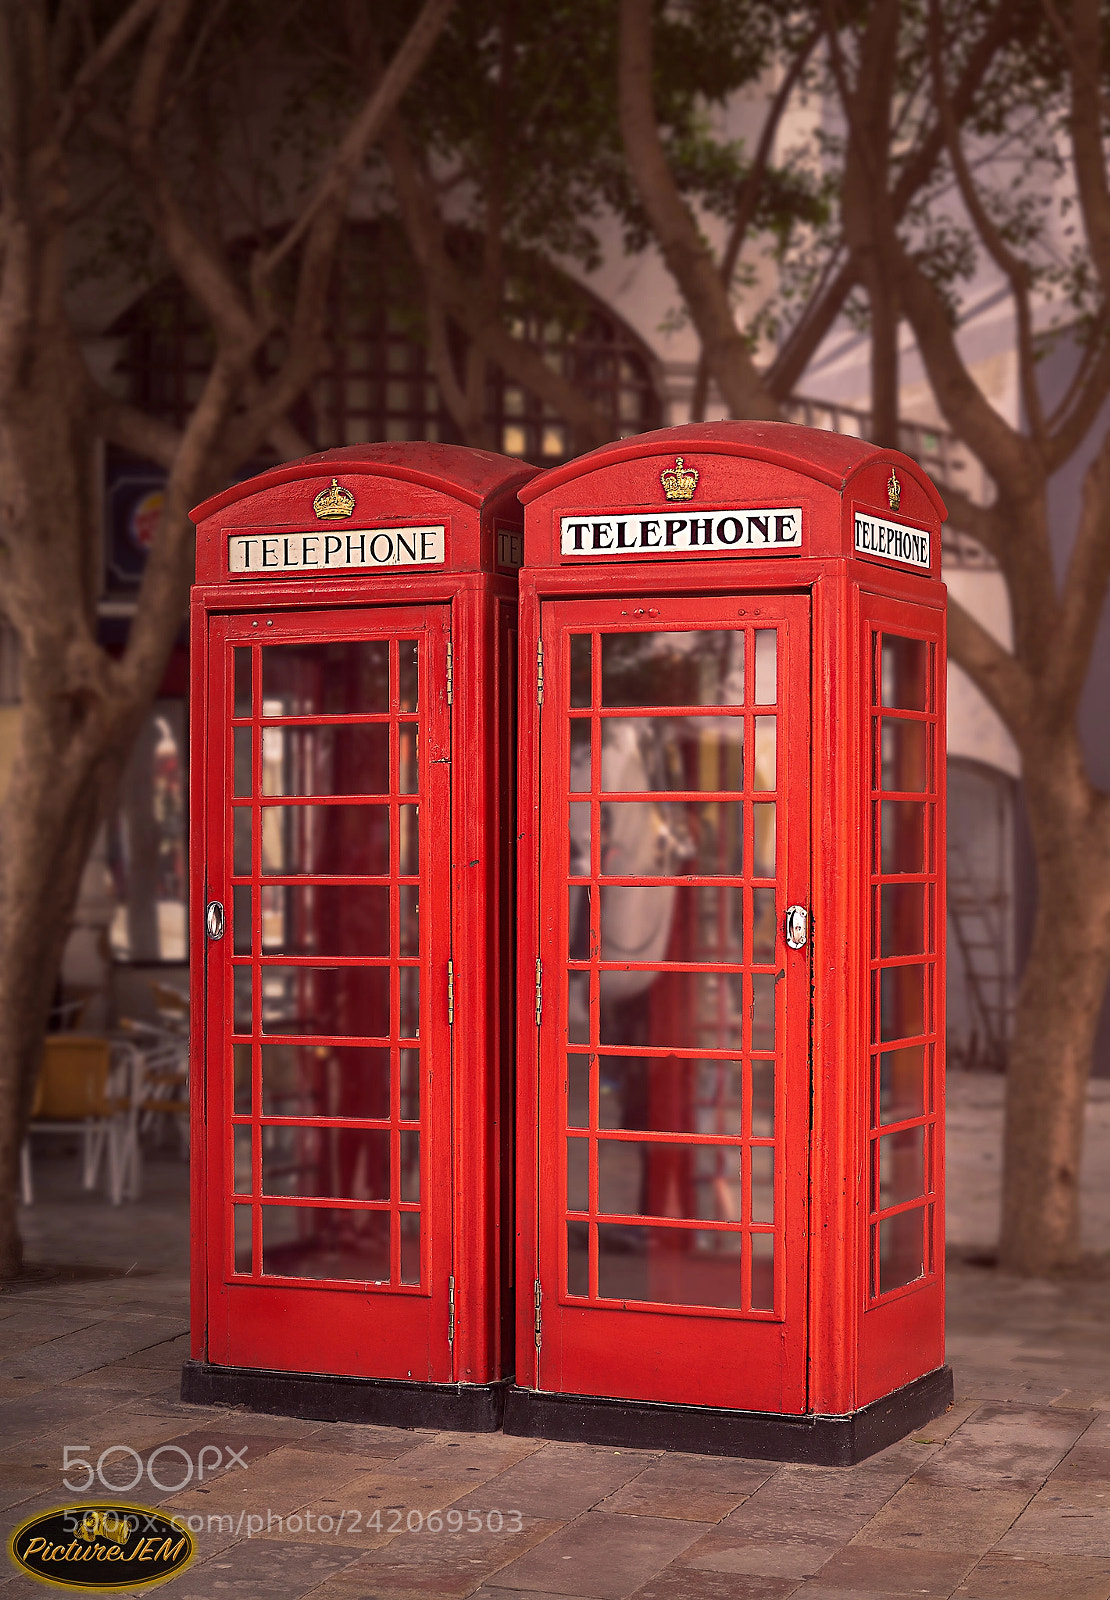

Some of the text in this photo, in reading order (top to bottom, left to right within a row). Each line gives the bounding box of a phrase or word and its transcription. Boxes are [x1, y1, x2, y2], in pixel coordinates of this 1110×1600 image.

[237, 532, 437, 568] TELEPHONE
[566, 515, 797, 550] TELEPHONE
[854, 519, 928, 563] TELEPHONE
